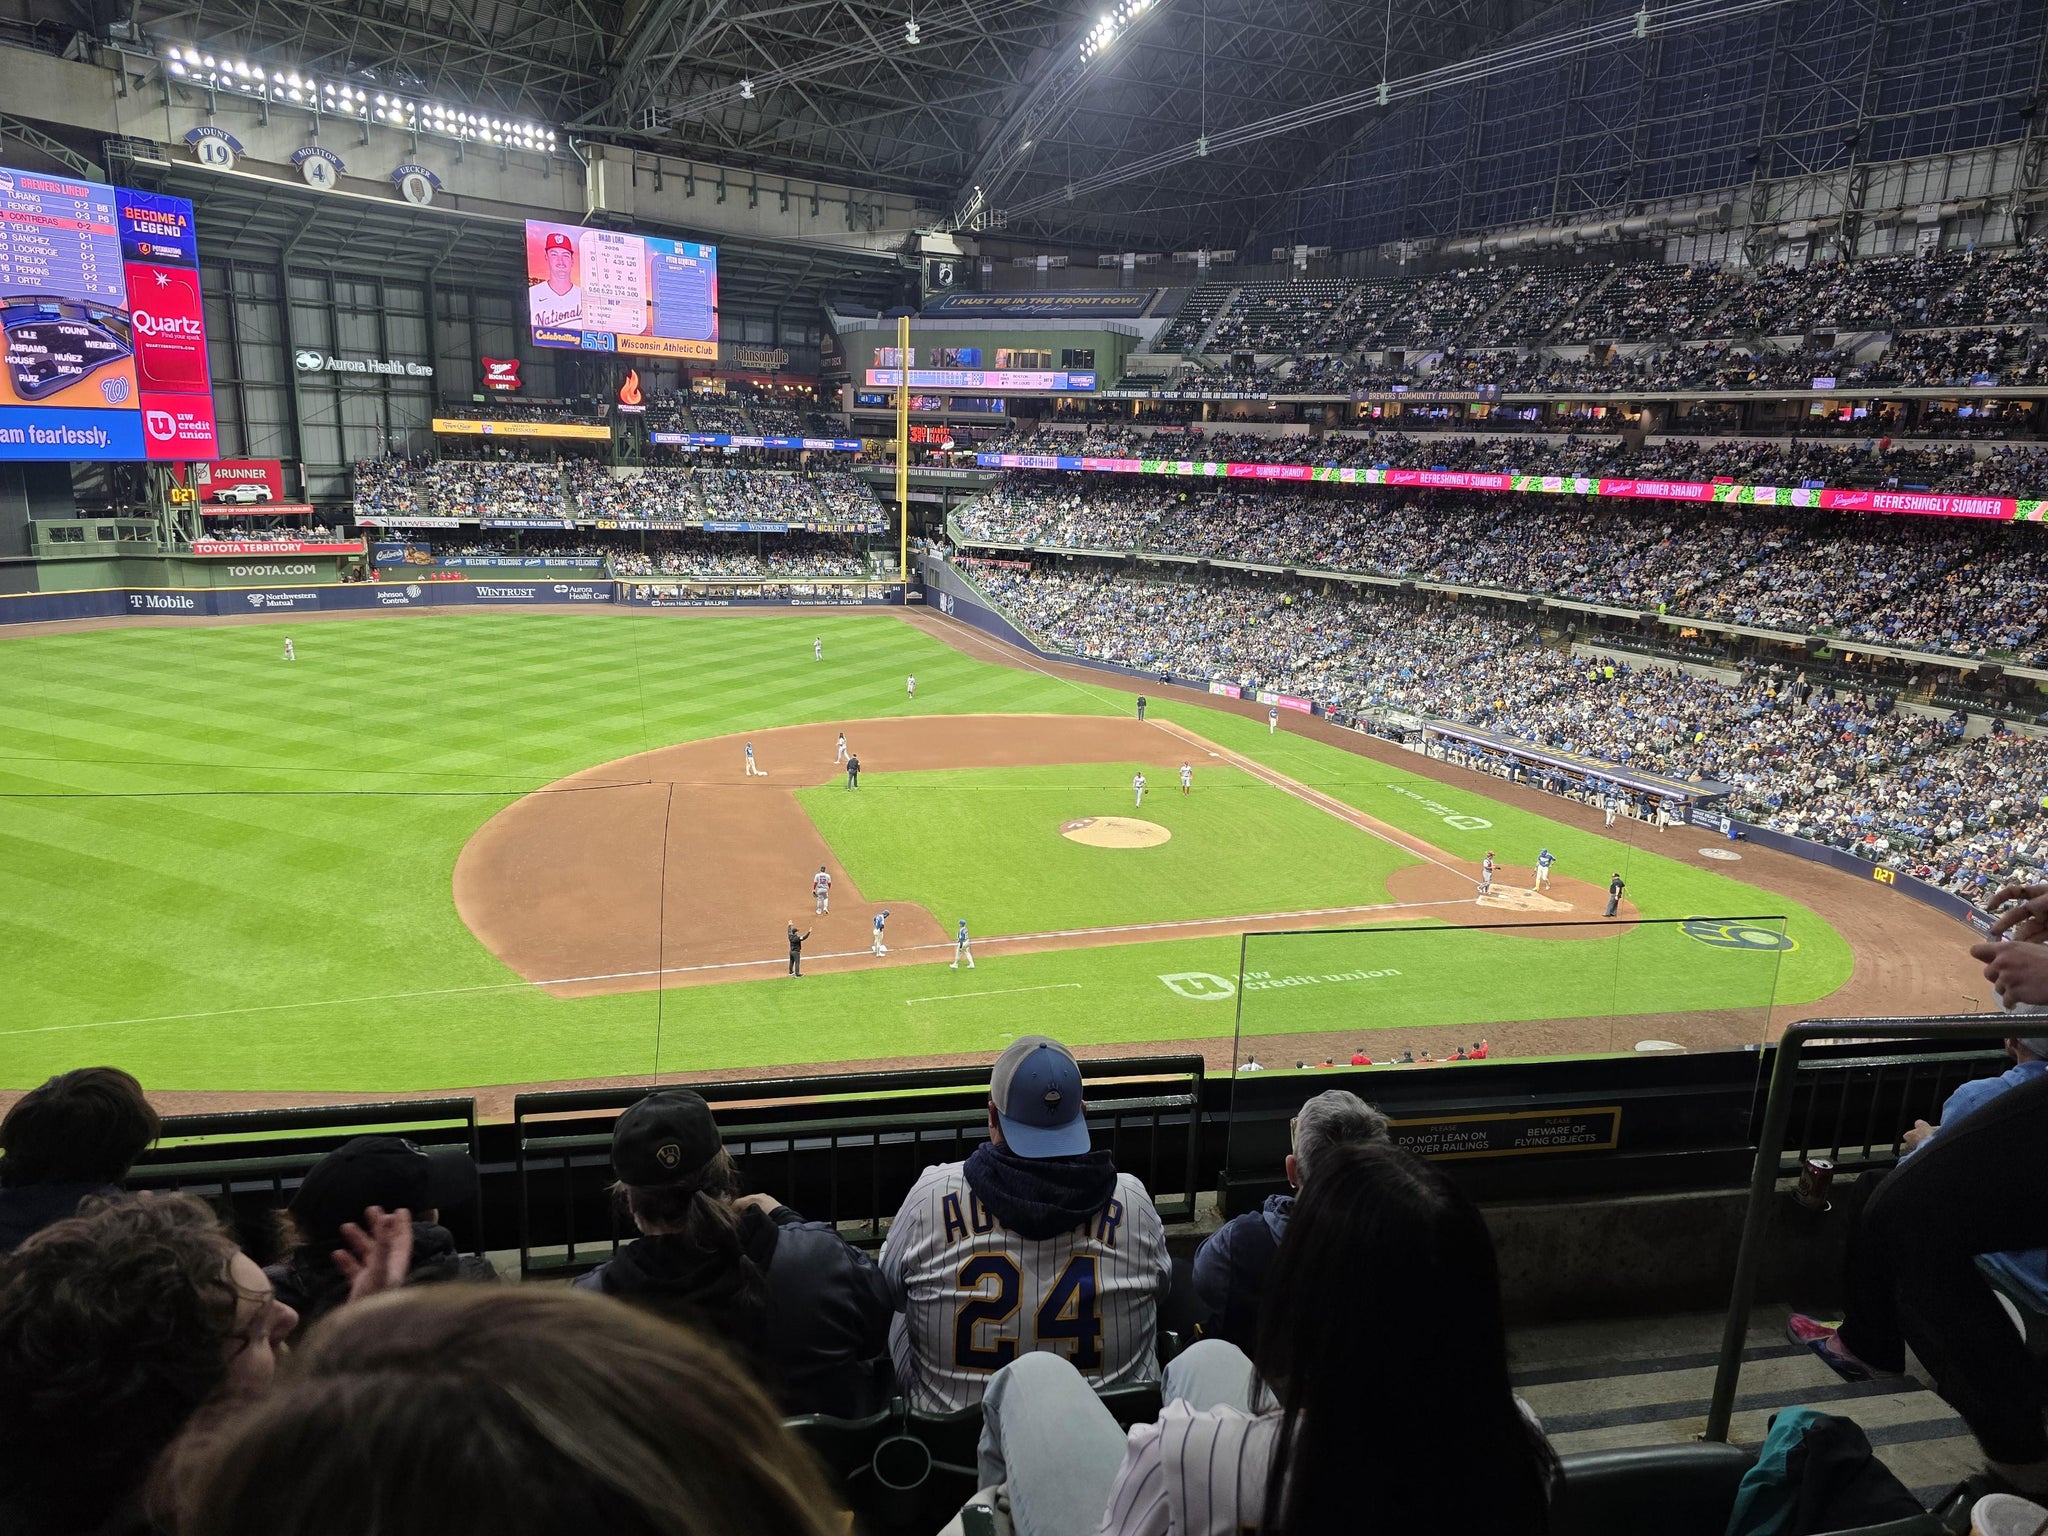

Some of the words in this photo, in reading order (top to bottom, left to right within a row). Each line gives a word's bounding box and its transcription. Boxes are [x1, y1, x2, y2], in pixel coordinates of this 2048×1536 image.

[197, 127, 230, 141] YOUNT
[203, 143, 229, 165] 19
[298, 148, 337, 163] MOLITOR
[313, 163, 325, 183] 4
[400, 167, 431, 178] UECKER
[21, 178, 60, 194] BREWERS
[61, 184, 90, 198] LINEUP
[7, 190, 41, 202] TURANG
[74, 201, 89, 210] 0-2
[7, 202, 42, 213] RENGIFO
[75, 212, 90, 220] 0-3
[125, 207, 175, 225] BECOME
[178, 215, 187, 227] A
[10, 212, 58, 225] CONTRERAS
[77, 222, 91, 230] 0-2
[11, 223, 40, 233] YELICH
[79, 232, 92, 240] 0-1
[134, 220, 181, 237] LEGEND
[13, 243, 59, 256] LOCKRIDGE
[81, 253, 95, 261] 0-2
[80, 242, 93, 250] 0-1
[14, 255, 48, 265] FRELICK
[82, 263, 96, 271] 0-2
[1, 264, 11, 272] 16
[16, 265, 50, 276] PERKINS
[83, 273, 98, 281] 0-2
[4, 275, 10, 283] 3
[17, 276, 42, 286] ORTIZ
[86, 284, 98, 292] 1-2
[107, 286, 117, 294] 1B
[132, 310, 202, 336] Quartz
[17, 330, 38, 340] LILE
[58, 326, 89, 336] YOUNG
[84, 340, 118, 350] WIEMER
[581, 330, 615, 351] 50
[620, 338, 661, 350] Wisconsin
[663, 342, 694, 354] Athletic
[695, 344, 713, 355] Club
[9, 343, 48, 353] ABRAMS
[4, 355, 36, 365] HOUSE
[54, 353, 84, 362] NUÑEZ
[733, 345, 789, 365] Johnsonville
[57, 365, 83, 374] MEAD
[325, 356, 366, 372] Aurora
[367, 359, 405, 376] Health
[405, 362, 433, 377] Care
[18, 374, 40, 382] RUIZ
[176, 412, 194, 421] uw
[178, 421, 211, 430] credit
[28, 424, 111, 448] fearlessly.
[179, 431, 212, 439] union
[214, 468, 267, 480] 4RUNNER
[1256, 466, 1280, 476] SUMMER
[1281, 467, 1304, 477] SHANDY
[1419, 474, 1469, 486] REFRESHINGLY
[1470, 476, 1502, 487] SUMMER
[171, 488, 196, 502] 0:27
[1636, 483, 1669, 496] SUMMER
[1671, 484, 1703, 497] SHANDY
[1873, 494, 1949, 512] REFRESHINGLY
[1951, 499, 2001, 515] SUMMER
[597, 521, 617, 529] 620
[619, 521, 649, 529] WTMJ
[748, 523, 784, 531] WINTRUST
[817, 524, 841, 532] NICOLET
[842, 524, 855, 532] LAW
[197, 544, 241, 553] TOYOTA
[243, 543, 302, 553] TERRITORY
[465, 558, 490, 566] WELCOME
[227, 565, 316, 577] TOYOTA.COM
[377, 591, 403, 599] Johnson
[476, 586, 535, 596] WINTRUST
[145, 595, 194, 608] Mobile
[1243, 974, 1320, 990] credit
[1321, 968, 1402, 982] union
[1545, 1117, 1571, 1125] PLEASE
[1431, 1124, 1456, 1132] PLEASE
[1527, 1127, 1570, 1136] BEWARE
[1572, 1125, 1586, 1134] OF
[1399, 1136, 1414, 1145] DO
[1417, 1134, 1439, 1144] NOT
[1441, 1132, 1468, 1142] LEAN
[1471, 1131, 1486, 1140] ON
[1514, 1136, 1549, 1147] FLYING
[1552, 1133, 1596, 1144] OBJECTS
[1412, 1144, 1440, 1153] OVER
[1442, 1141, 1489, 1152] RAILINGS
[953, 1251, 1104, 1375] 24
